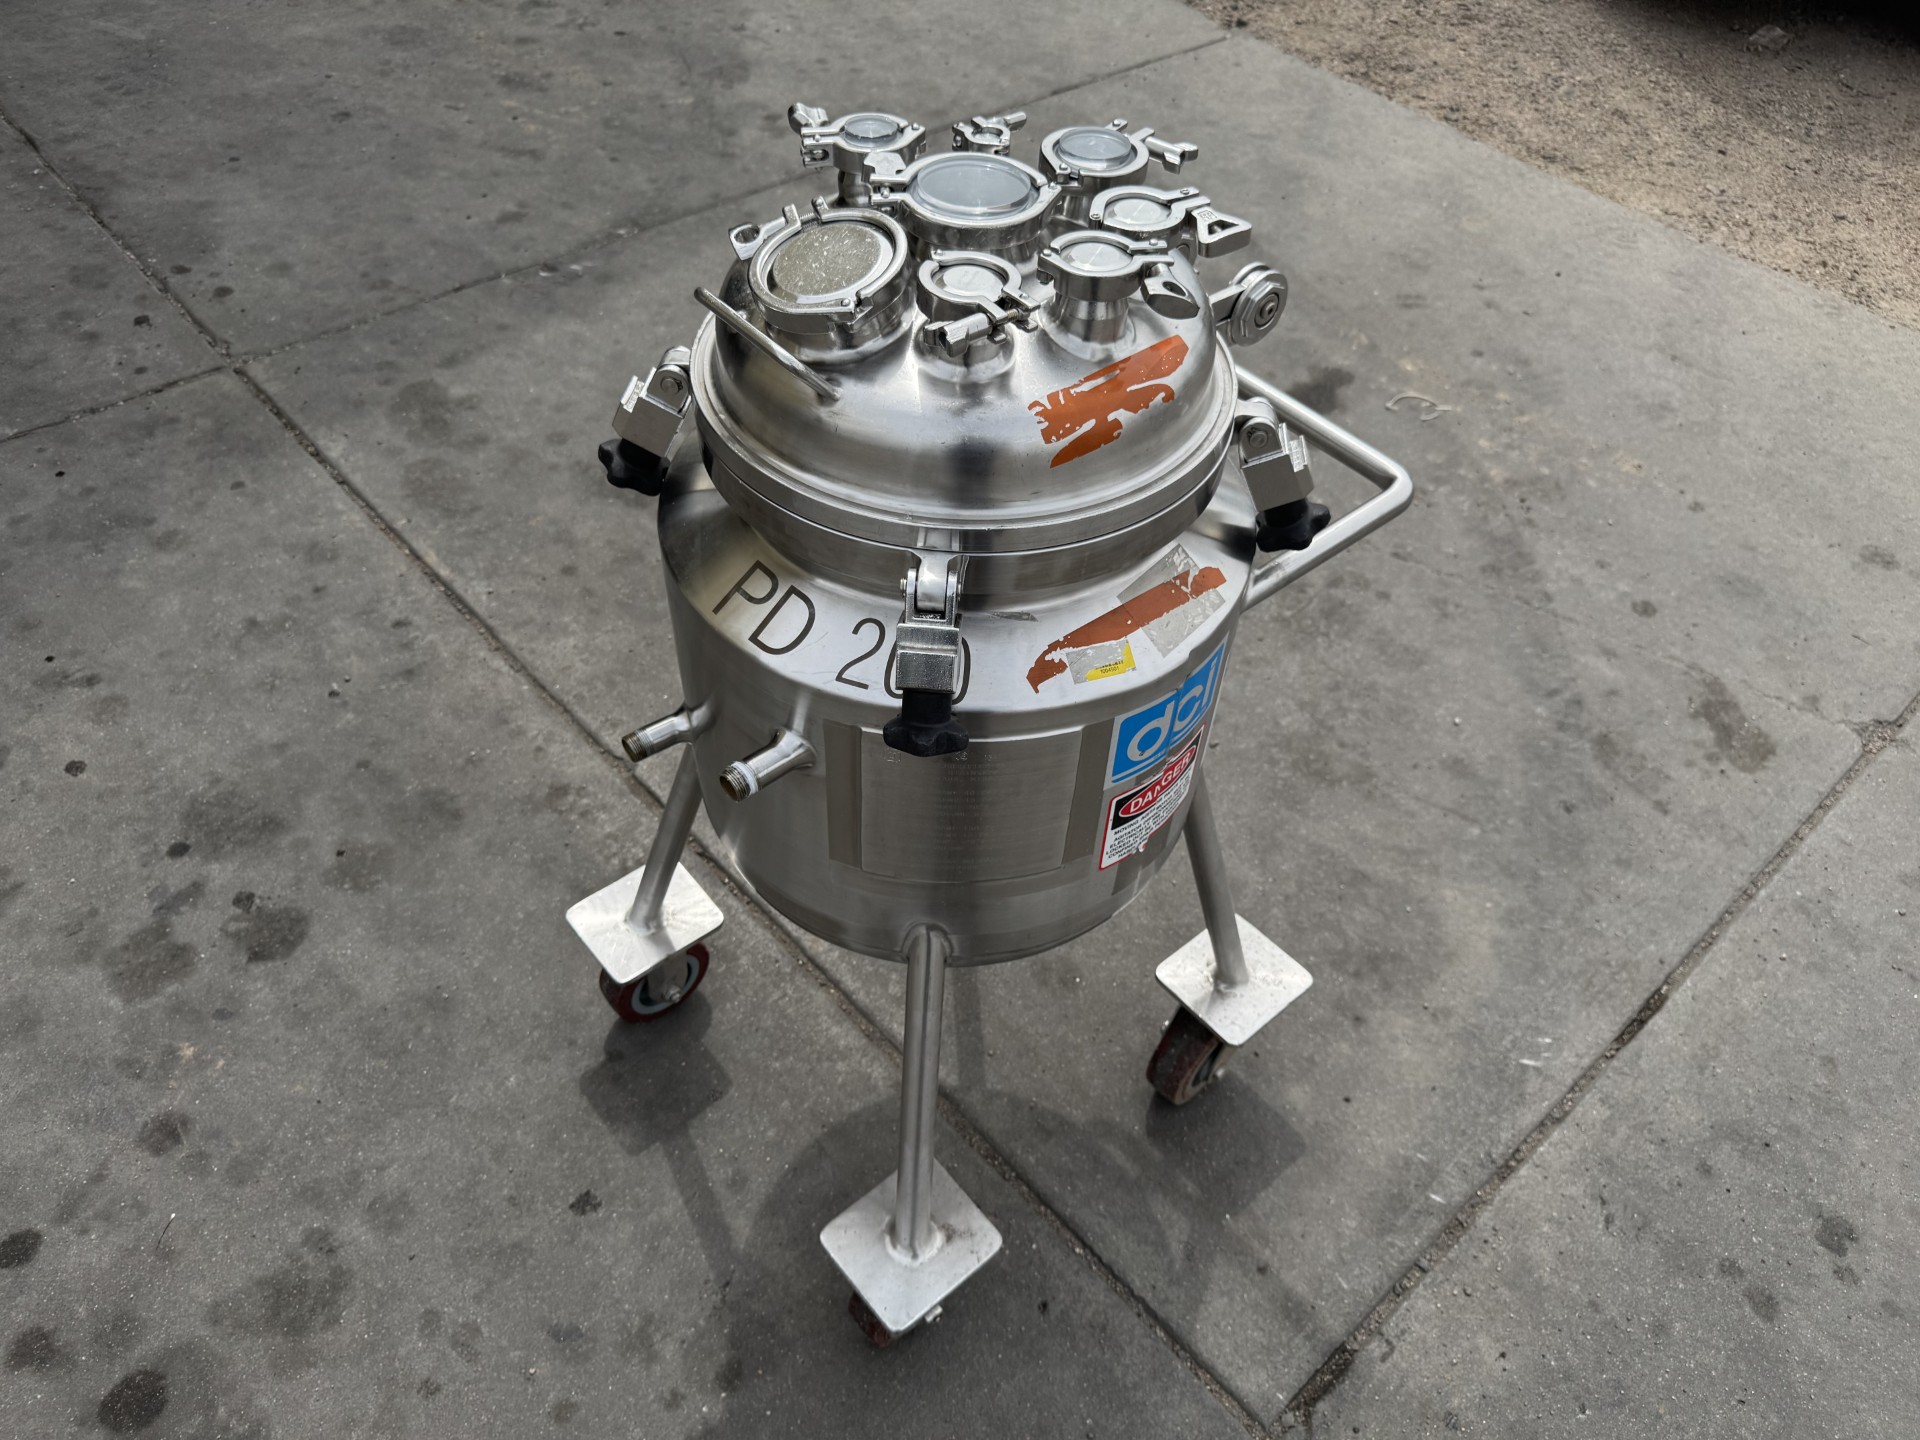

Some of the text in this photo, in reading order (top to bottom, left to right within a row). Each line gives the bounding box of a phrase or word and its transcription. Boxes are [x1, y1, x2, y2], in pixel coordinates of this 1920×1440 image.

[712, 560, 816, 655] PD
[1130, 752, 1191, 813] DANGER
[1114, 820, 1138, 835] MOVING
